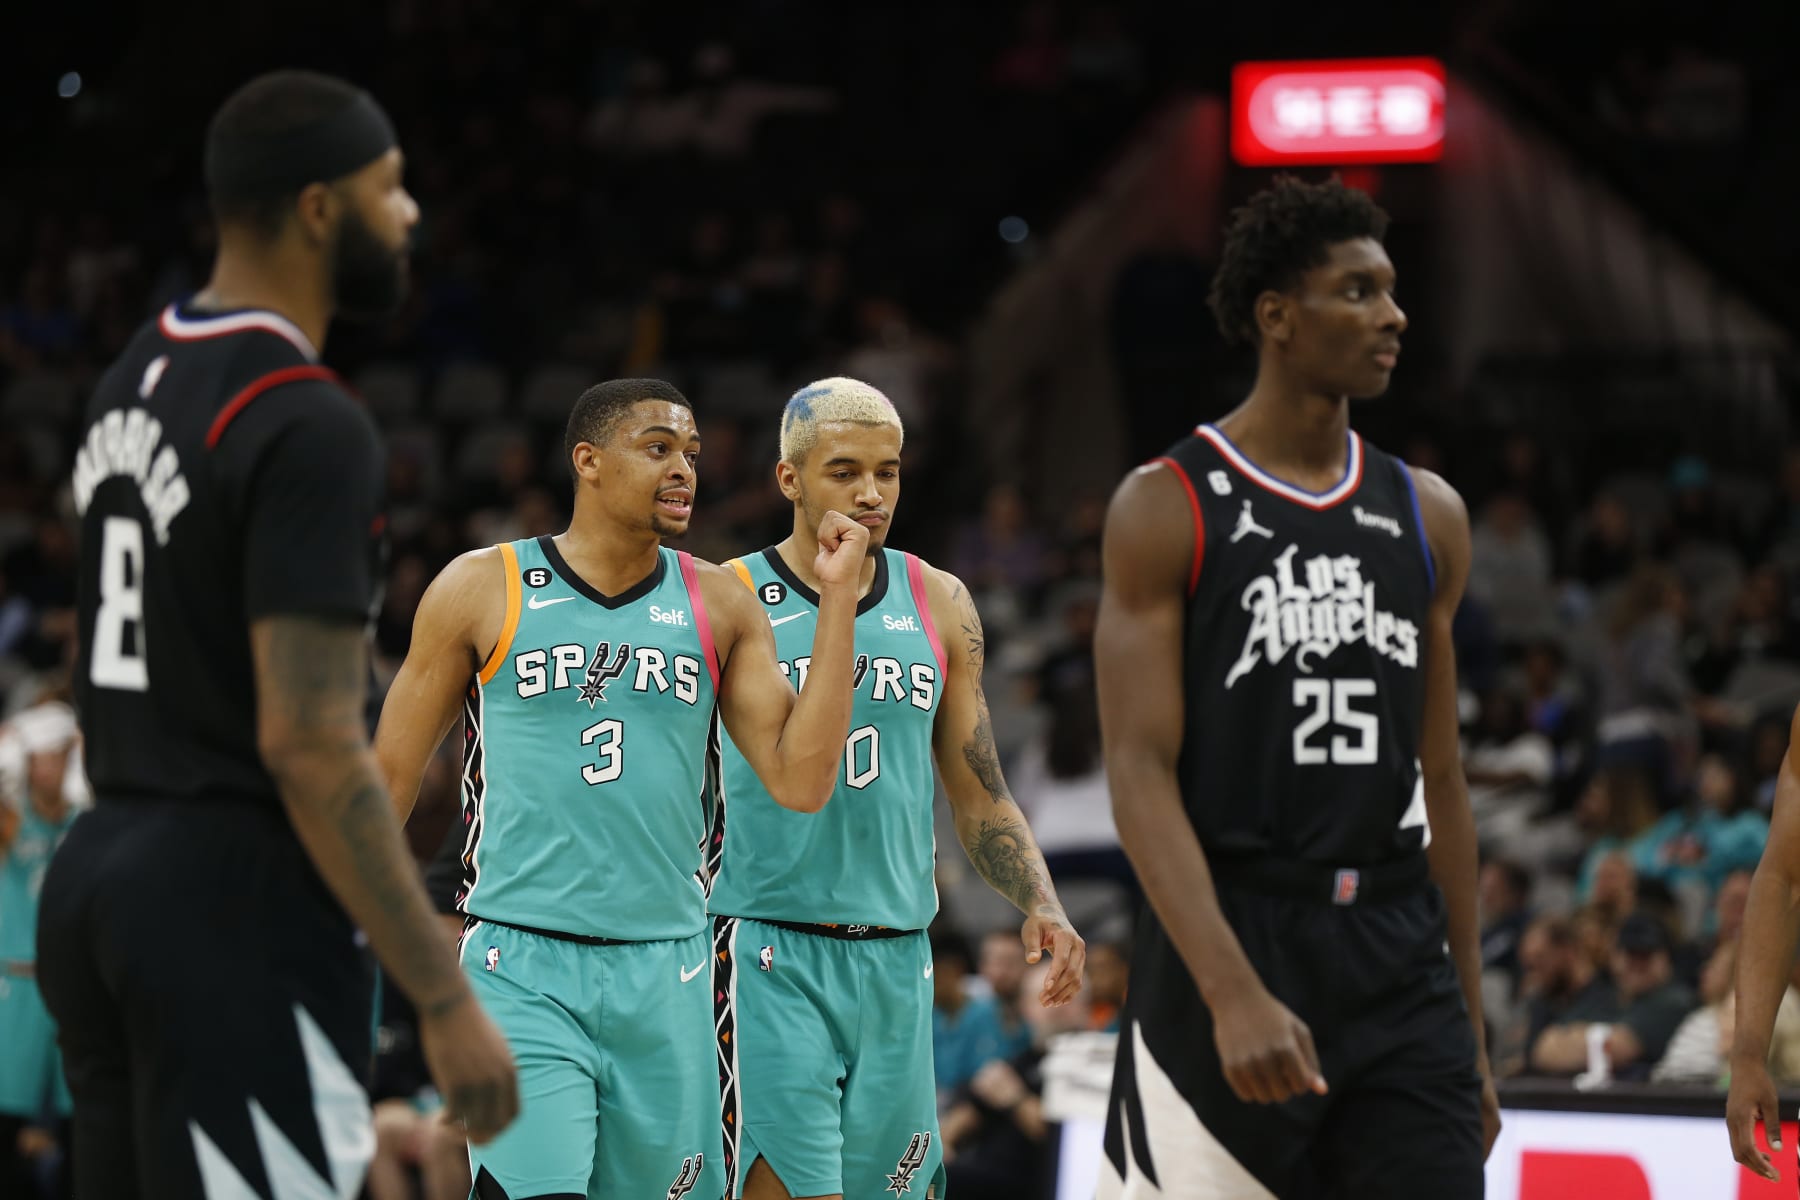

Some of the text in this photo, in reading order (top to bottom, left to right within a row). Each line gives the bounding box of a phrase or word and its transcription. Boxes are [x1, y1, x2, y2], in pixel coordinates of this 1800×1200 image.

[89, 514, 150, 691] 8
[529, 570, 546, 587] 6
[765, 584, 781, 603] 6
[1273, 543, 1364, 601] Los
[649, 604, 689, 626] Self.
[882, 614, 920, 632] Self.
[1224, 574, 1420, 690] Angeles
[515, 641, 701, 709] SPURS
[580, 717, 625, 786] 3
[1292, 677, 1379, 766] 25
